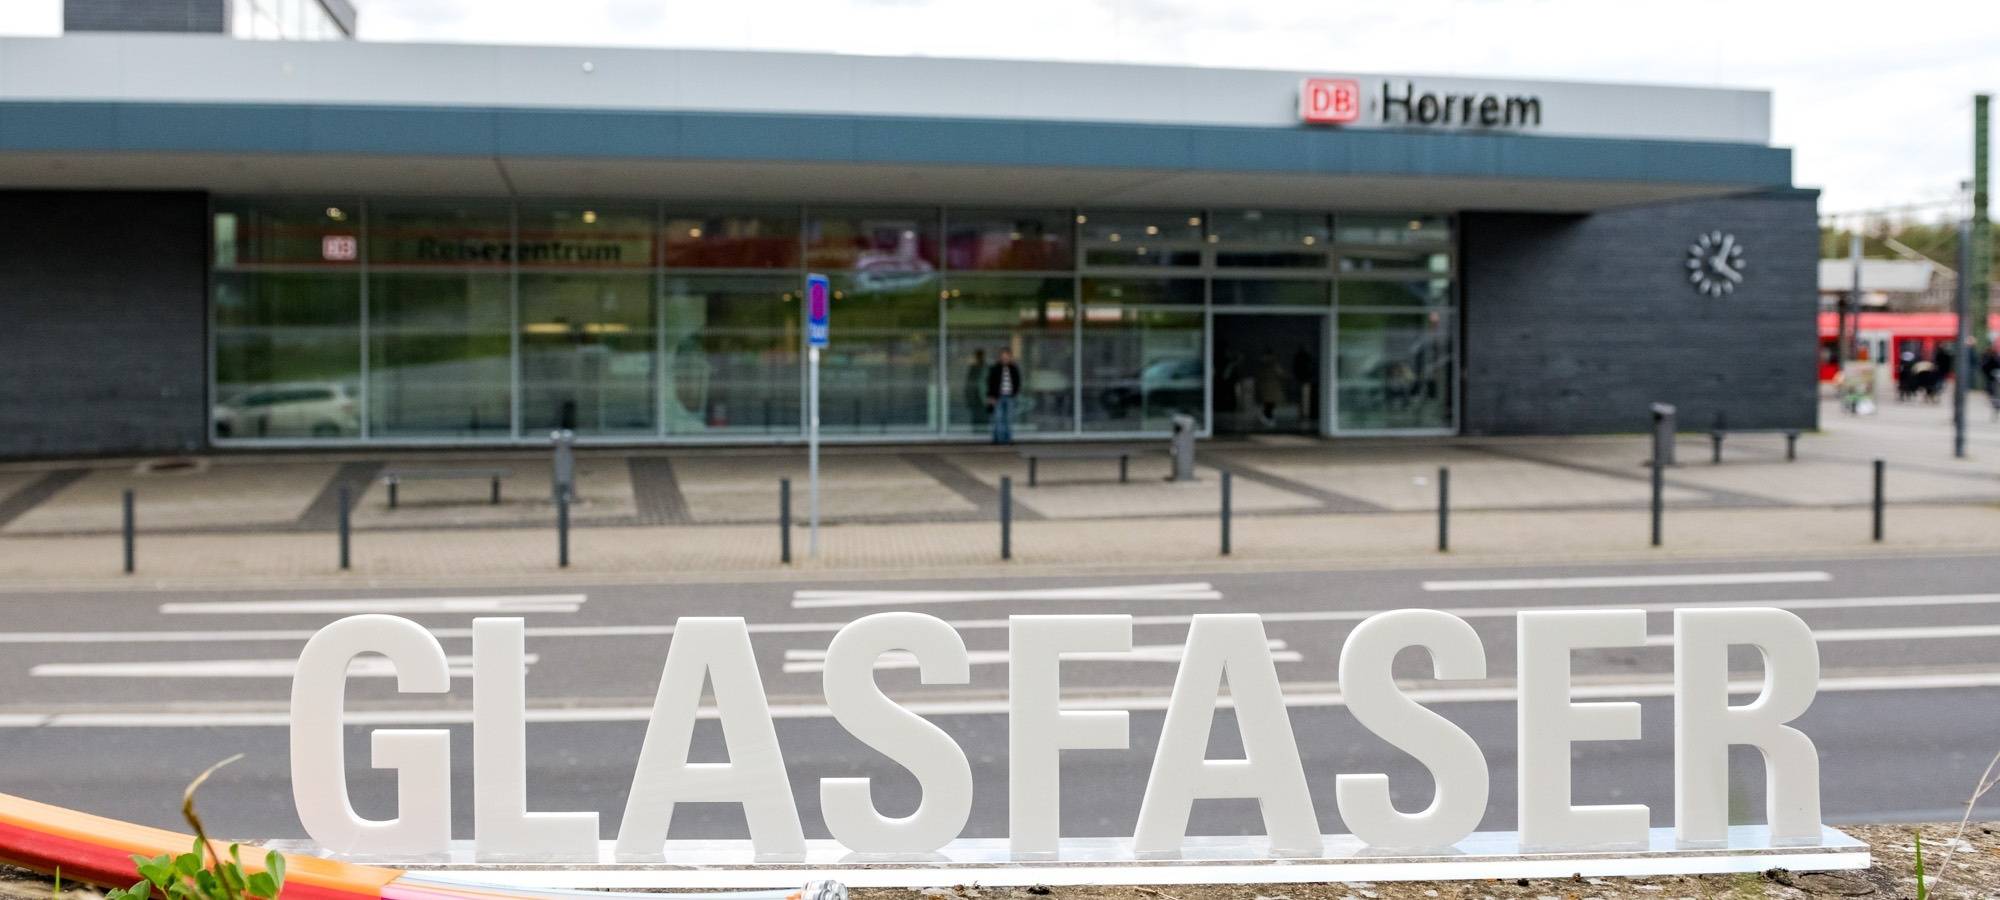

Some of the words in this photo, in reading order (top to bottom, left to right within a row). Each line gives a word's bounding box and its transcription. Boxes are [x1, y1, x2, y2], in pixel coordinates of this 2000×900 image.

[1310, 85, 1353, 116] DB
[1382, 81, 1542, 125] Horrem
[418, 237, 622, 261] Reisezentrum
[290, 607, 1822, 857] GLASFASER
